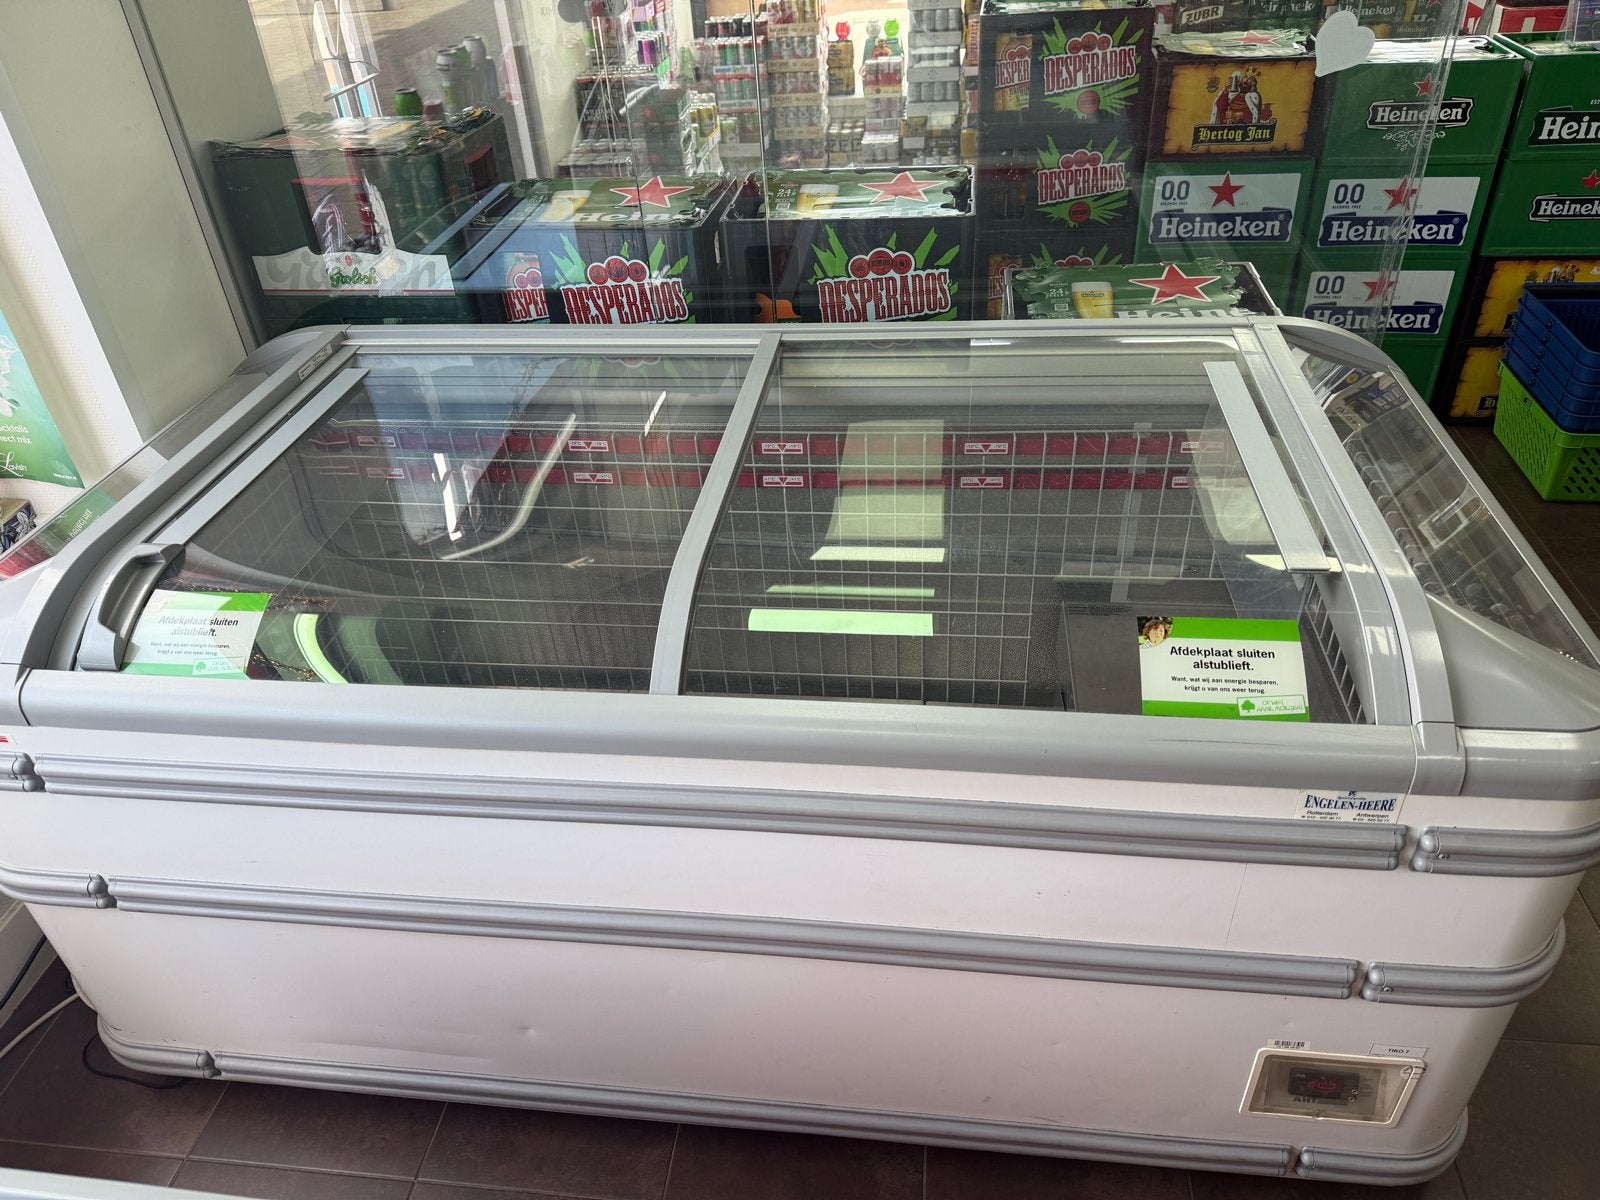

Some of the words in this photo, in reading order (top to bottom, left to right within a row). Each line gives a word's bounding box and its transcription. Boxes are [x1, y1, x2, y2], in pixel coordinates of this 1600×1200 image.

[1185, 7, 1220, 23] ZUBR
[1043, 46, 1136, 94] DESPERADOS
[1199, 128, 1243, 141] Hertog
[1246, 126, 1271, 140] Jan
[1037, 162, 1126, 205] DESPERADOS
[1161, 180, 1191, 201] 0.0
[1333, 183, 1365, 204] 0.0
[1159, 216, 1281, 239] Heineken
[330, 267, 378, 288] Grolsch
[1316, 275, 1345, 294] 0.0
[561, 280, 688, 324] DESPERADOS
[819, 269, 950, 323] DESPERADOS
[158, 615, 207, 626] Afdekplaat
[209, 617, 239, 626] sluiten
[171, 627, 217, 637] alstublieft.
[1170, 646, 1233, 658] Afdekplaat
[1237, 649, 1275, 658] sluiten
[1193, 660, 1254, 671] alstublieft.
[1304, 794, 1397, 811] ENGELEN-HEERE
